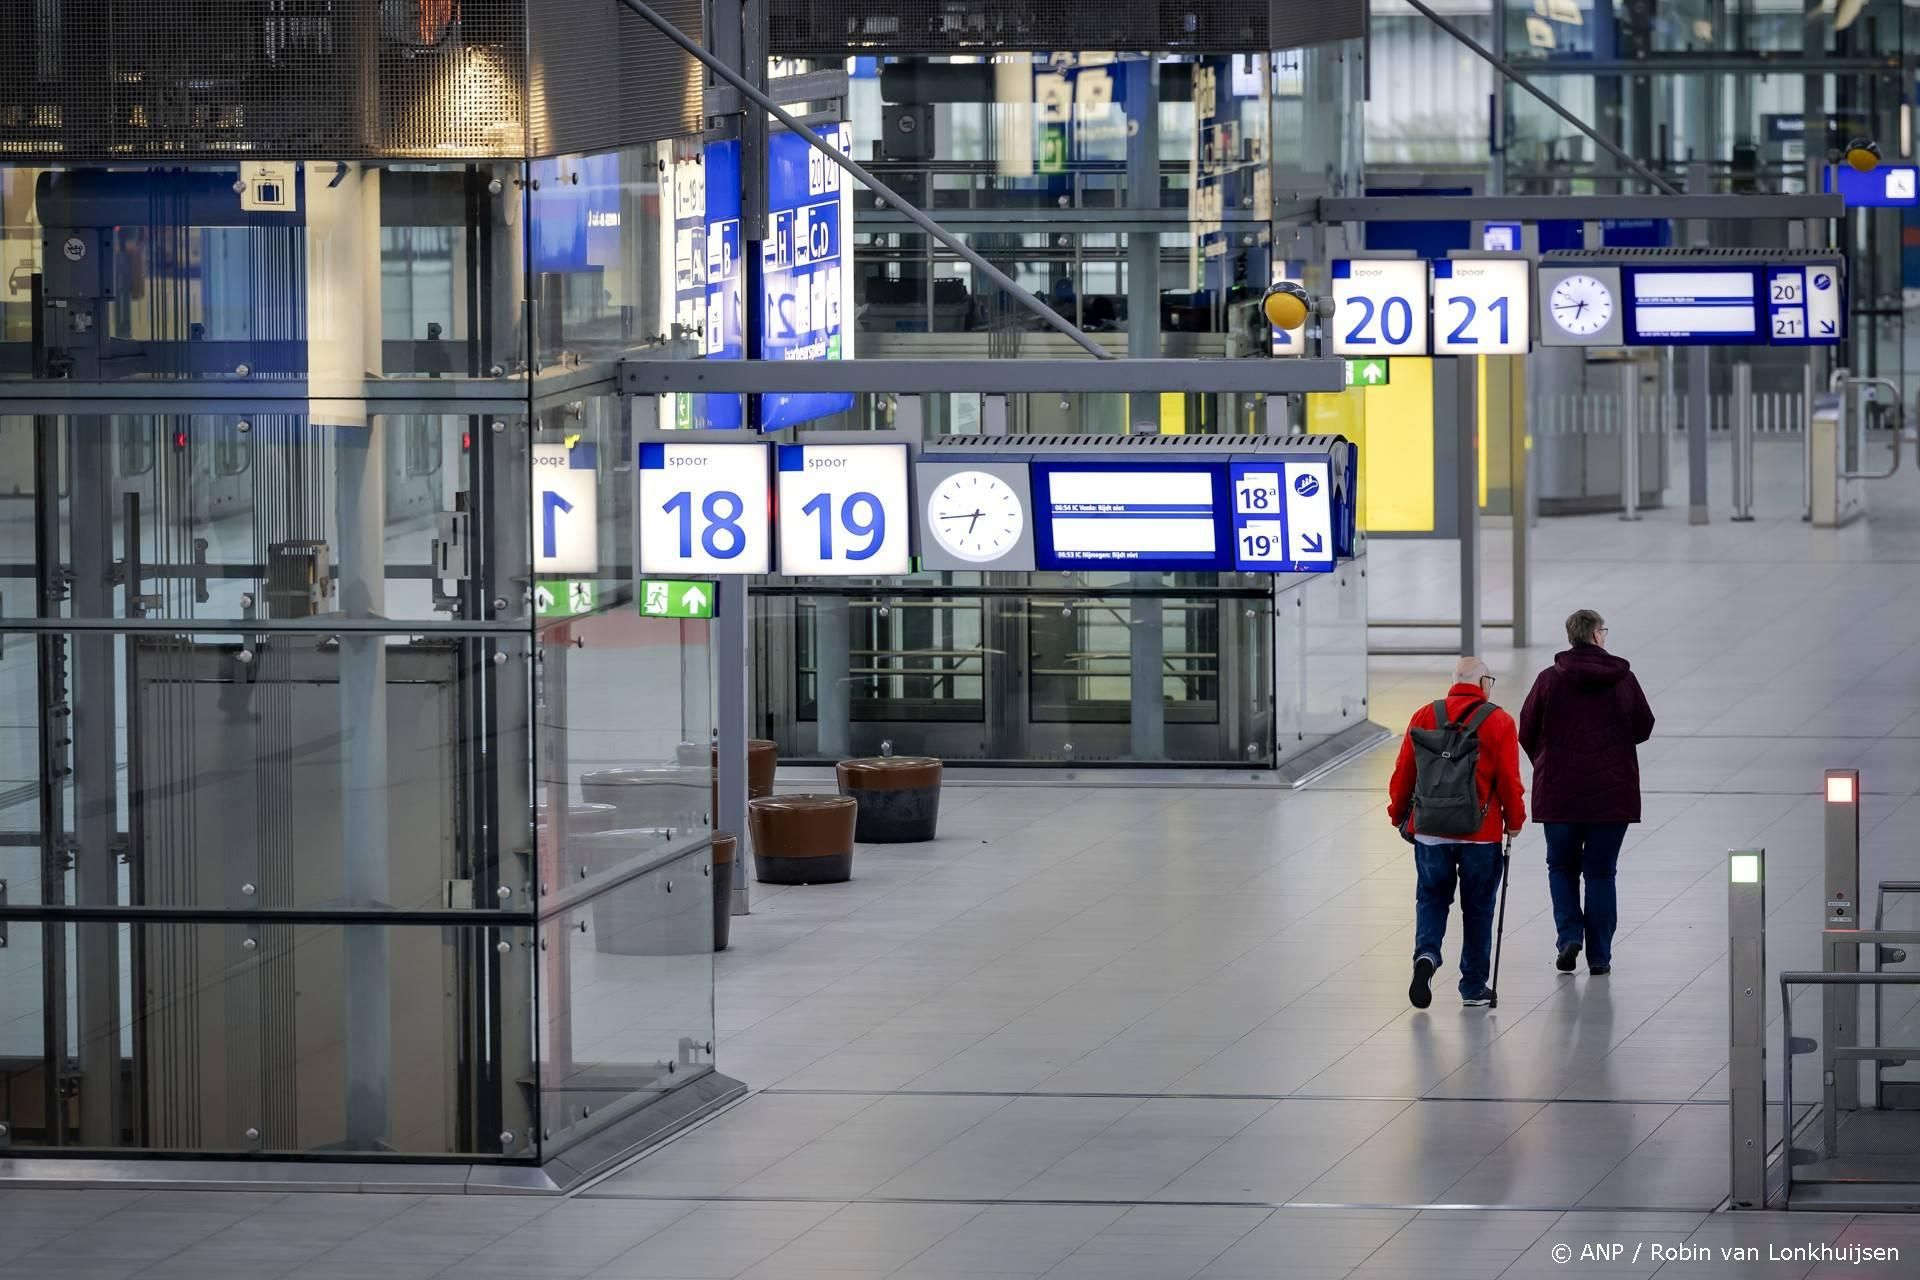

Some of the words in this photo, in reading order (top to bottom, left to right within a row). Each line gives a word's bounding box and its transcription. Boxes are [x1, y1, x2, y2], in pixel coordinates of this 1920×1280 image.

[723, 242, 731, 275] B
[779, 230, 787, 264] H
[1355, 269, 1383, 277] spoor
[1456, 269, 1485, 277] spoor
[1345, 296, 1413, 345] 20
[1447, 296, 1509, 344] 21
[669, 455, 708, 468] spoor
[808, 456, 848, 468] spoor
[662, 491, 746, 560] 18
[801, 491, 886, 560] 19
[1075, 551, 1082, 559] IC
